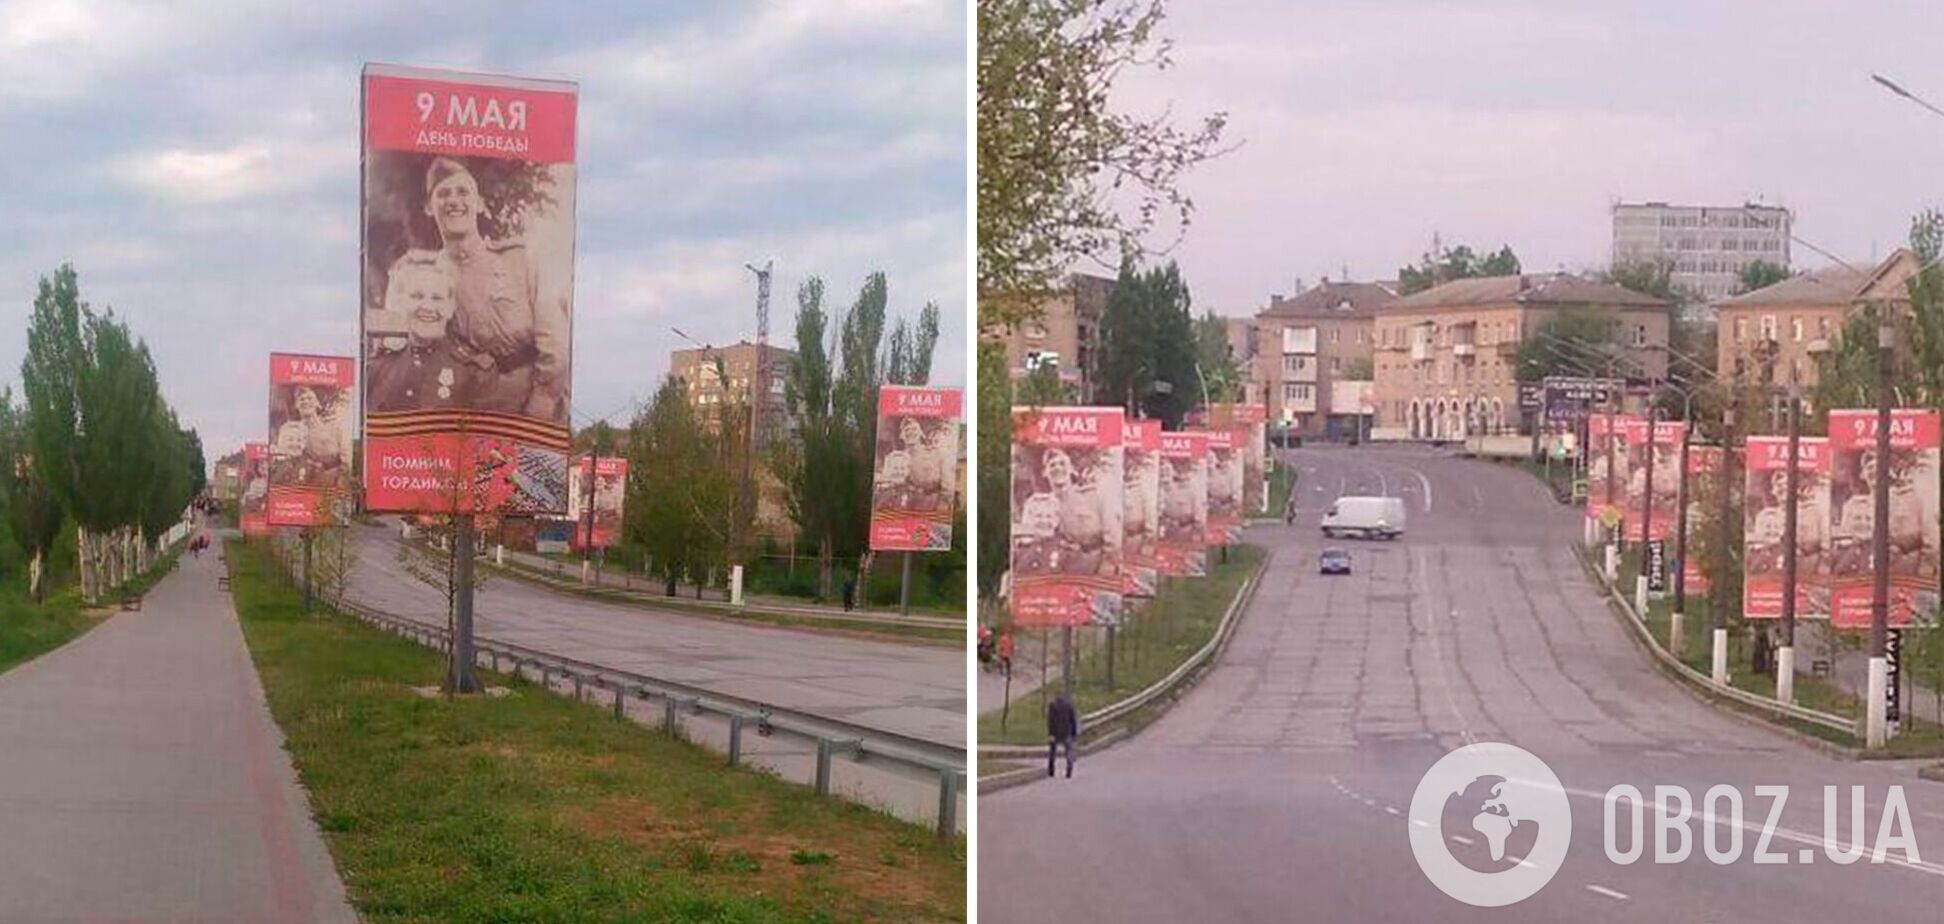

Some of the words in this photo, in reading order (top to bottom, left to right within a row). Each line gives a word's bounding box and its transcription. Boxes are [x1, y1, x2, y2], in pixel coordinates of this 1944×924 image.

[416, 92, 435, 122] 9
[447, 95, 528, 131] МАЯ
[416, 130, 458, 147] ДЕНЬ
[461, 133, 529, 153] ПОБЕДЫ
[1053, 416, 1097, 434] МАЯ
[1854, 419, 1865, 436] 9
